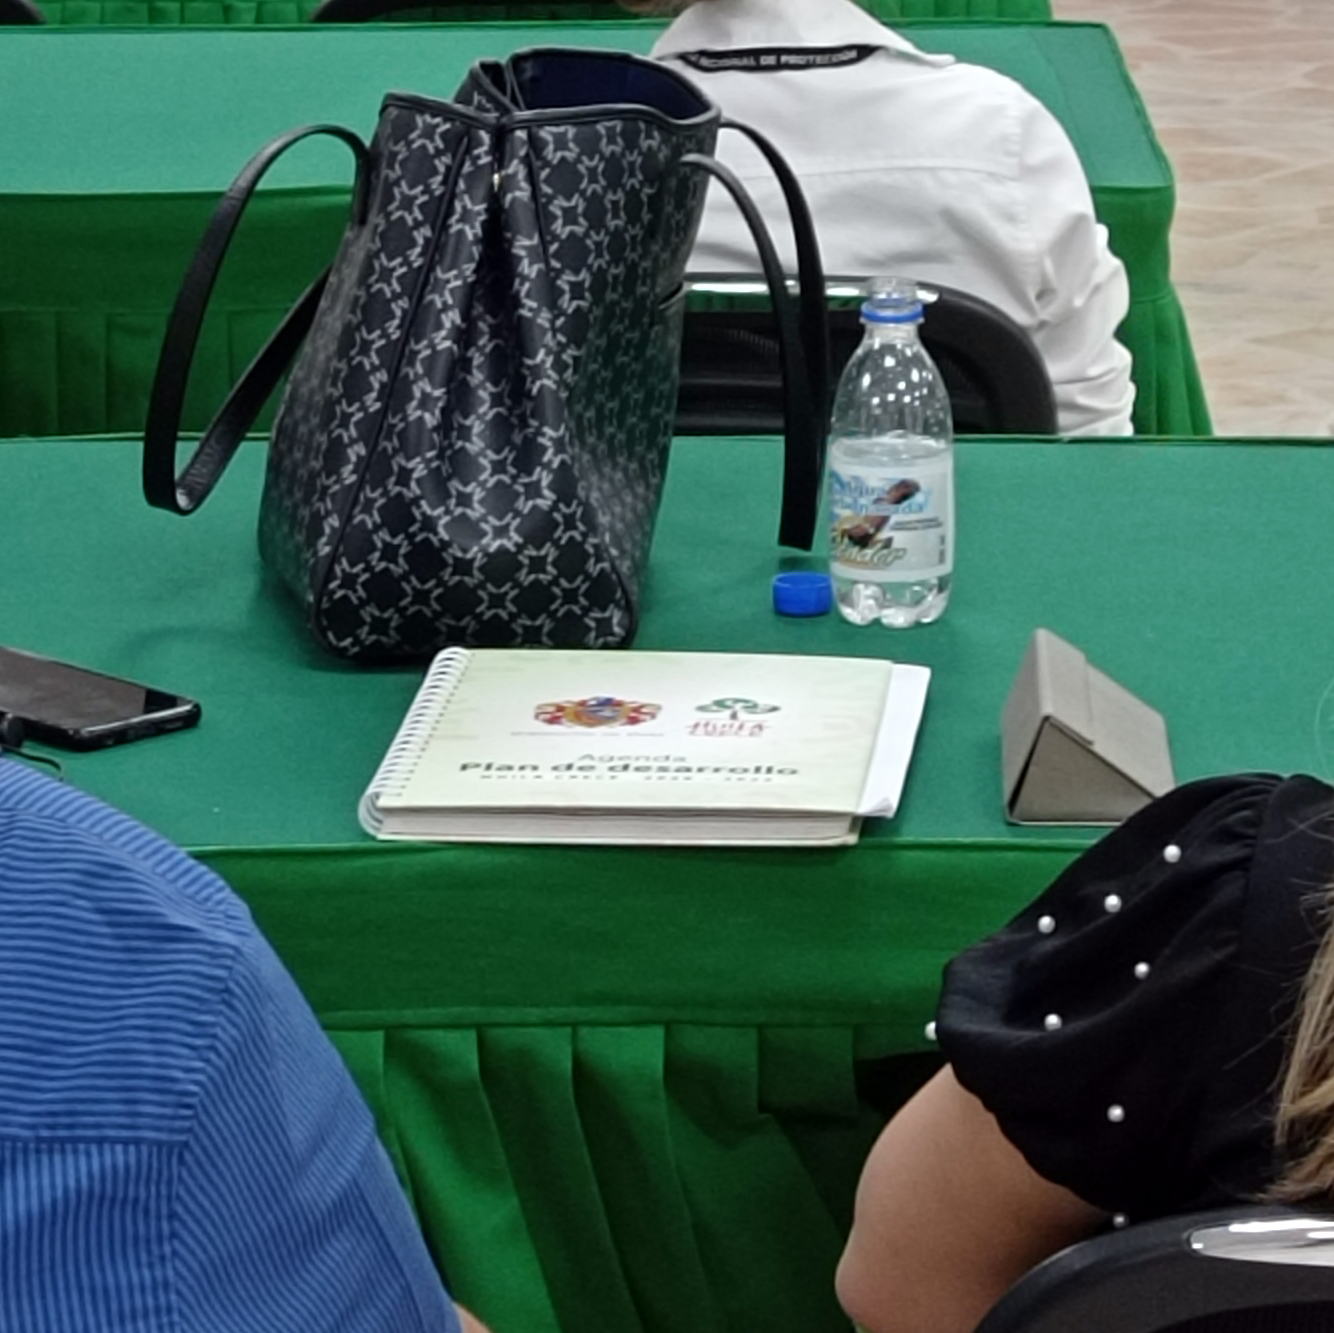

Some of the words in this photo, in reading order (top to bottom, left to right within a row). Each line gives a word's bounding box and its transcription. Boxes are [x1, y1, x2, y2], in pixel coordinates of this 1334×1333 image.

[577, 753, 687, 763] Agenda
[459, 761, 539, 772] Plan
[551, 762, 597, 773] de
[607, 762, 798, 776] desarrollo
